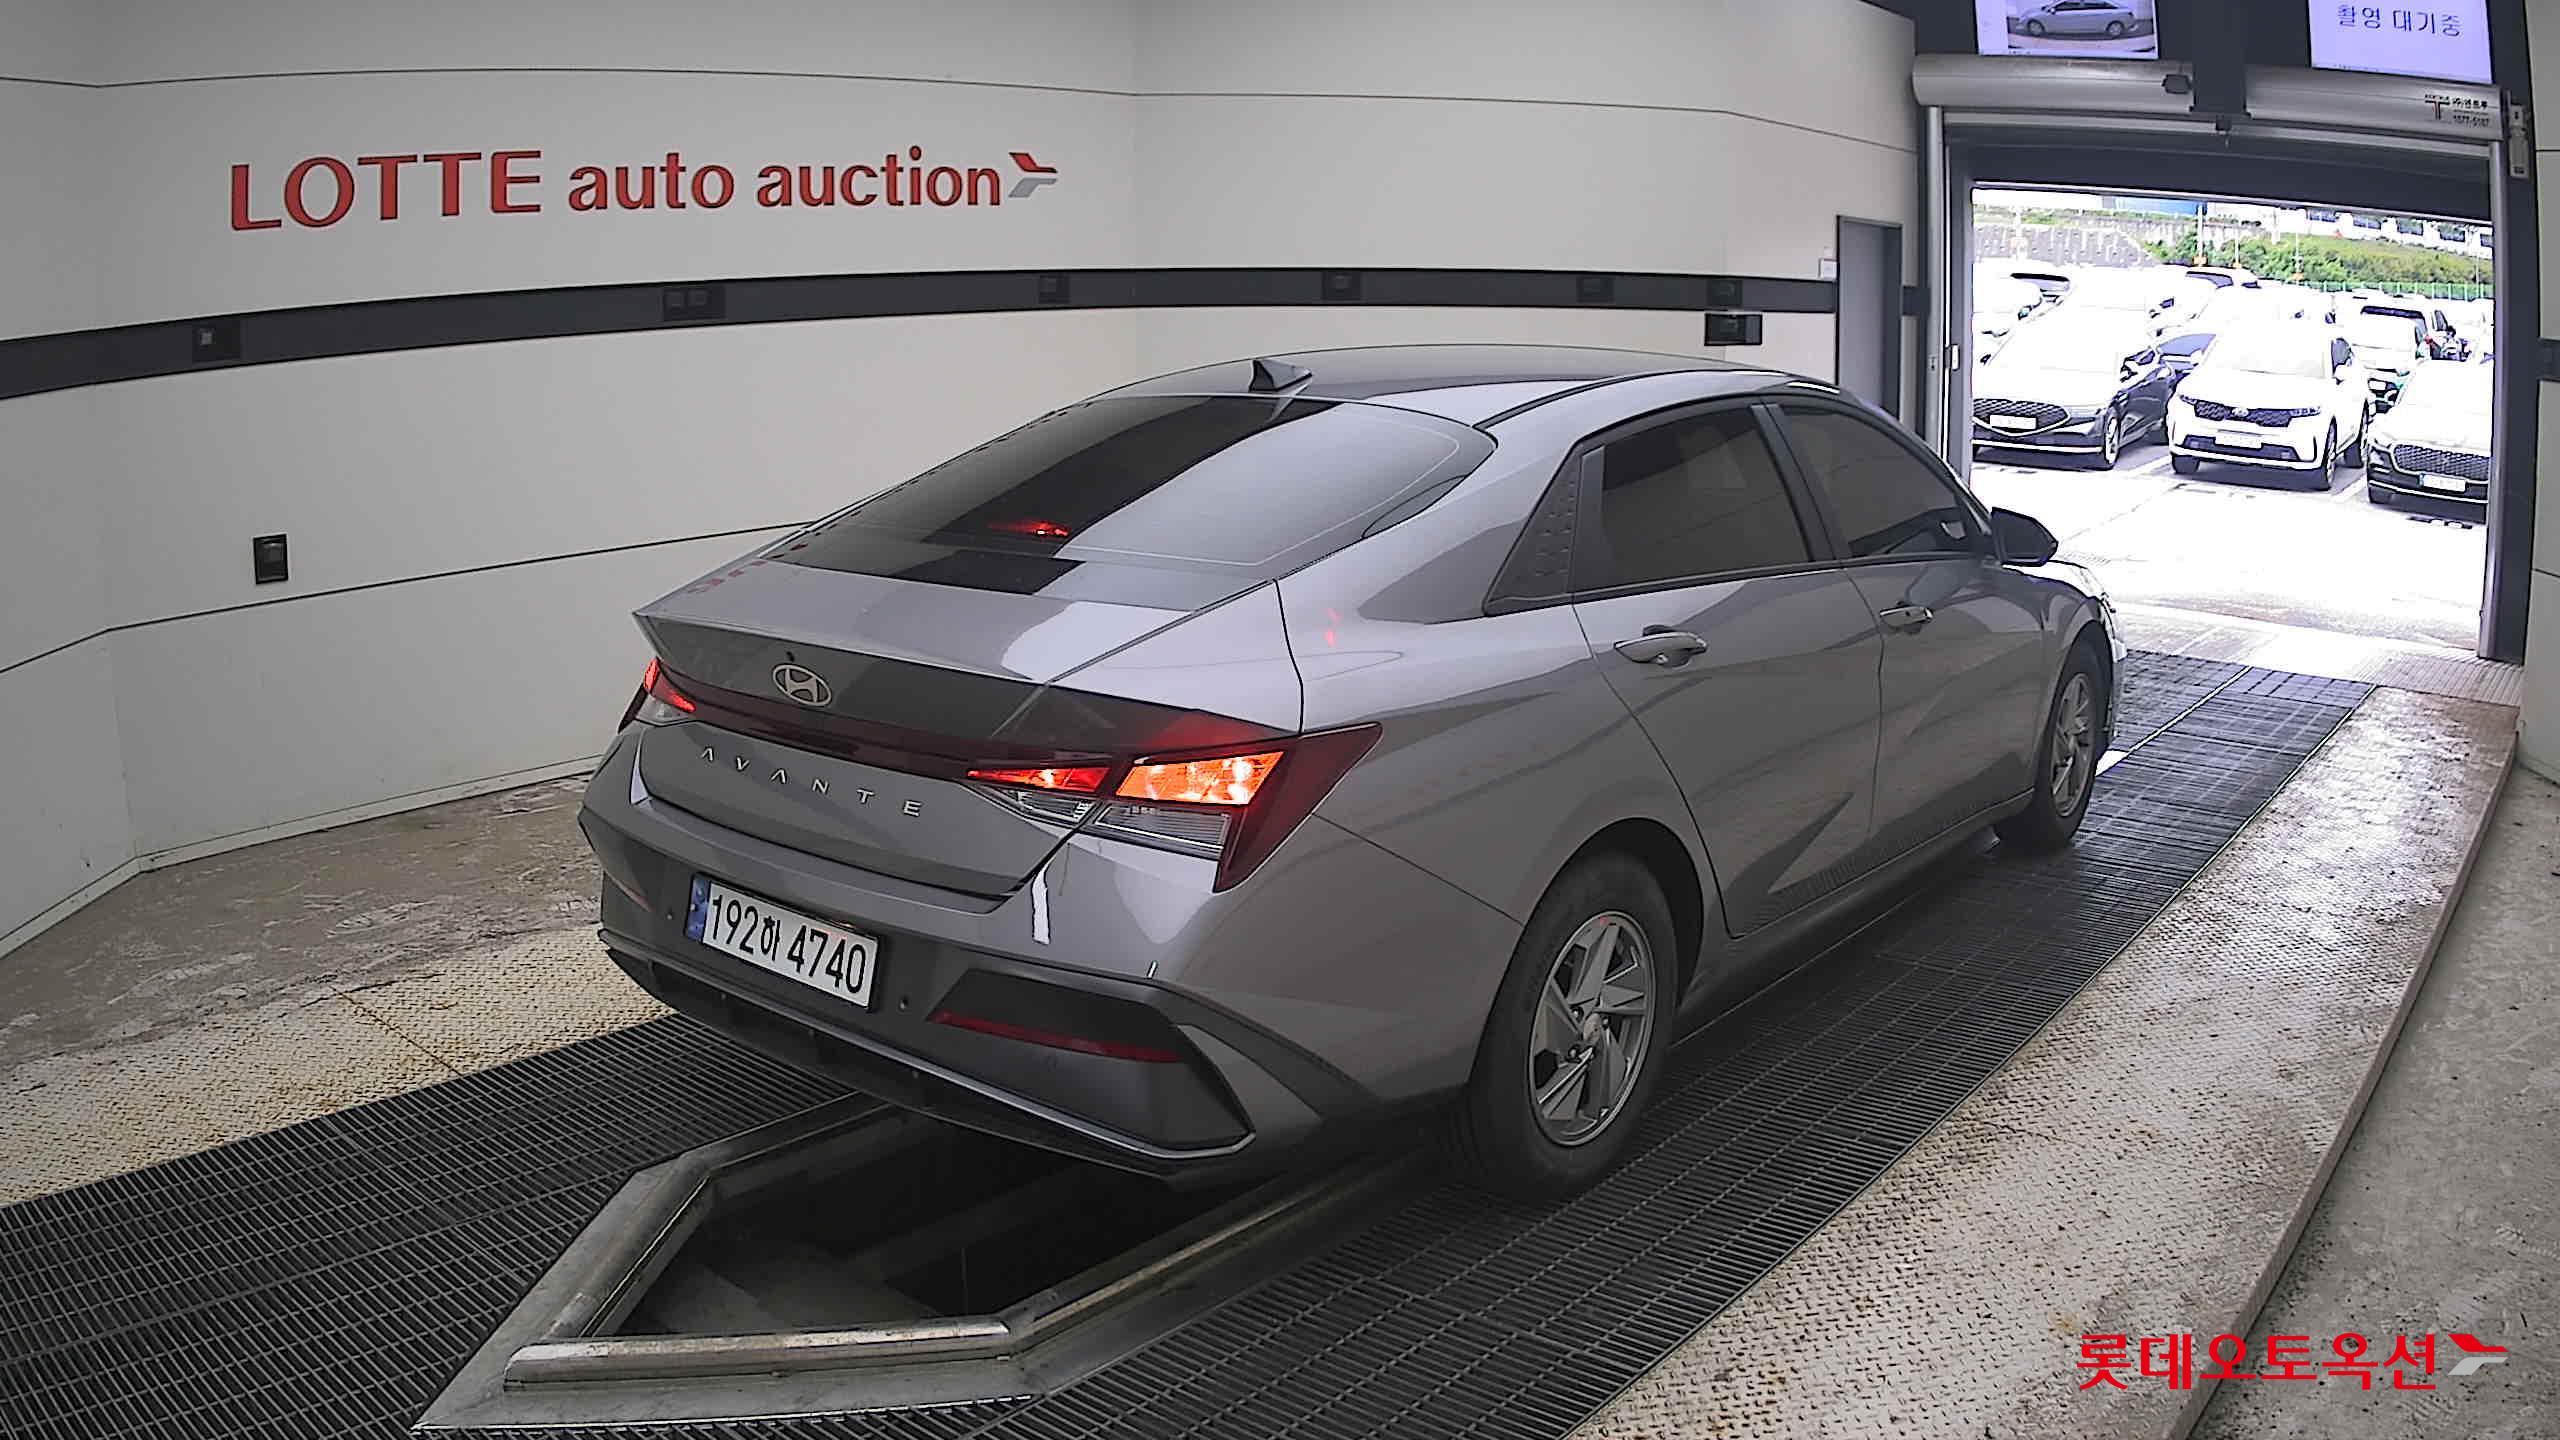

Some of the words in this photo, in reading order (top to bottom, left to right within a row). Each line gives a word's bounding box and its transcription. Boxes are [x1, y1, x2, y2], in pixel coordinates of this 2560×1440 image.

[2338, 4, 2381, 30] 촬영
[2392, 9, 2460, 37] 대기중
[230, 150, 542, 231] LOTTE
[568, 151, 735, 211] auto
[756, 145, 1001, 207] auction
[701, 747, 922, 817] AVANTE
